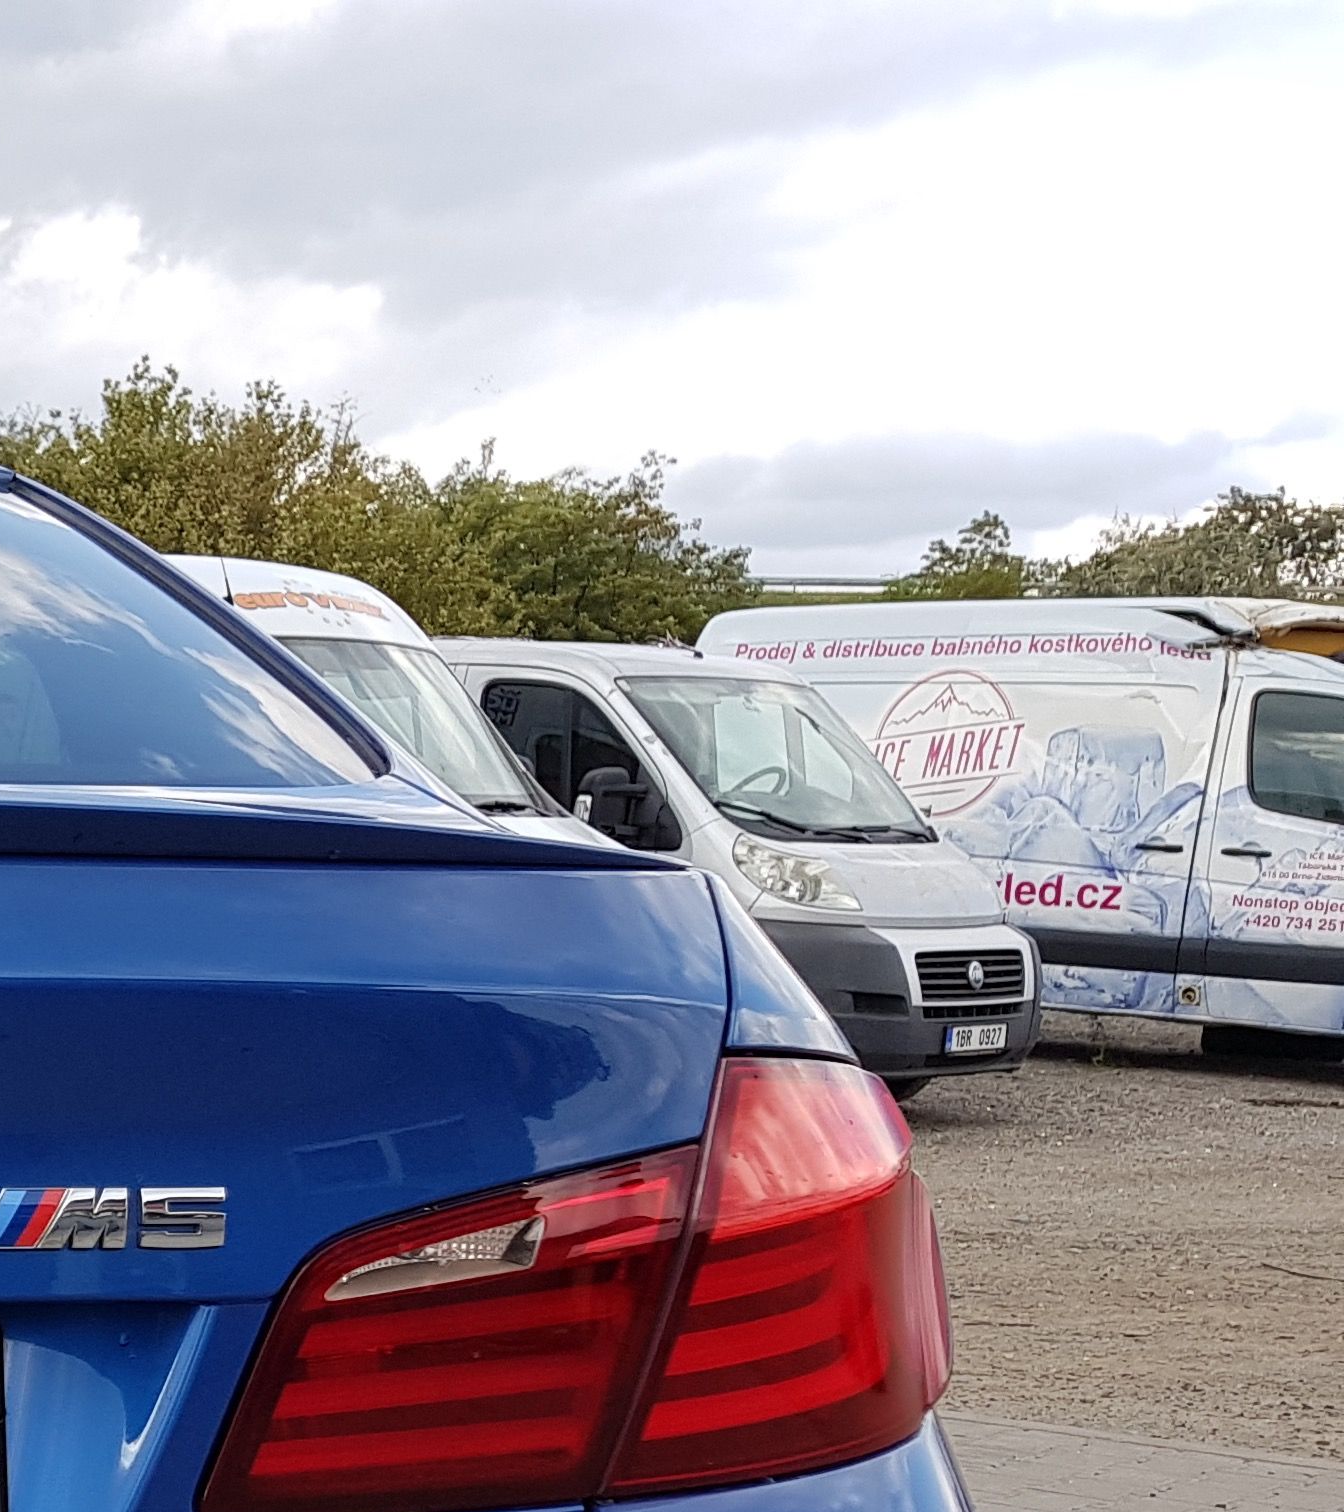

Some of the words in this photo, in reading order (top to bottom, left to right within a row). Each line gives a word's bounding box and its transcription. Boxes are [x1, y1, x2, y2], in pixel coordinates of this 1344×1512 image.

[734, 641, 798, 664] Prodej
[802, 641, 816, 659] &
[822, 639, 925, 659] distribuce
[930, 635, 1022, 657] baleného
[1028, 632, 1153, 655] kostkového
[921, 723, 1026, 780] MARKET
[996, 872, 1123, 910] led.cz
[1232, 894, 1299, 913] Nonstop
[1244, 914, 1281, 928] +420
[1286, 916, 1312, 930] 734
[955, 1029, 973, 1048] 1BR
[978, 1027, 1003, 1046] 0927
[36, 1186, 227, 1250] M5
